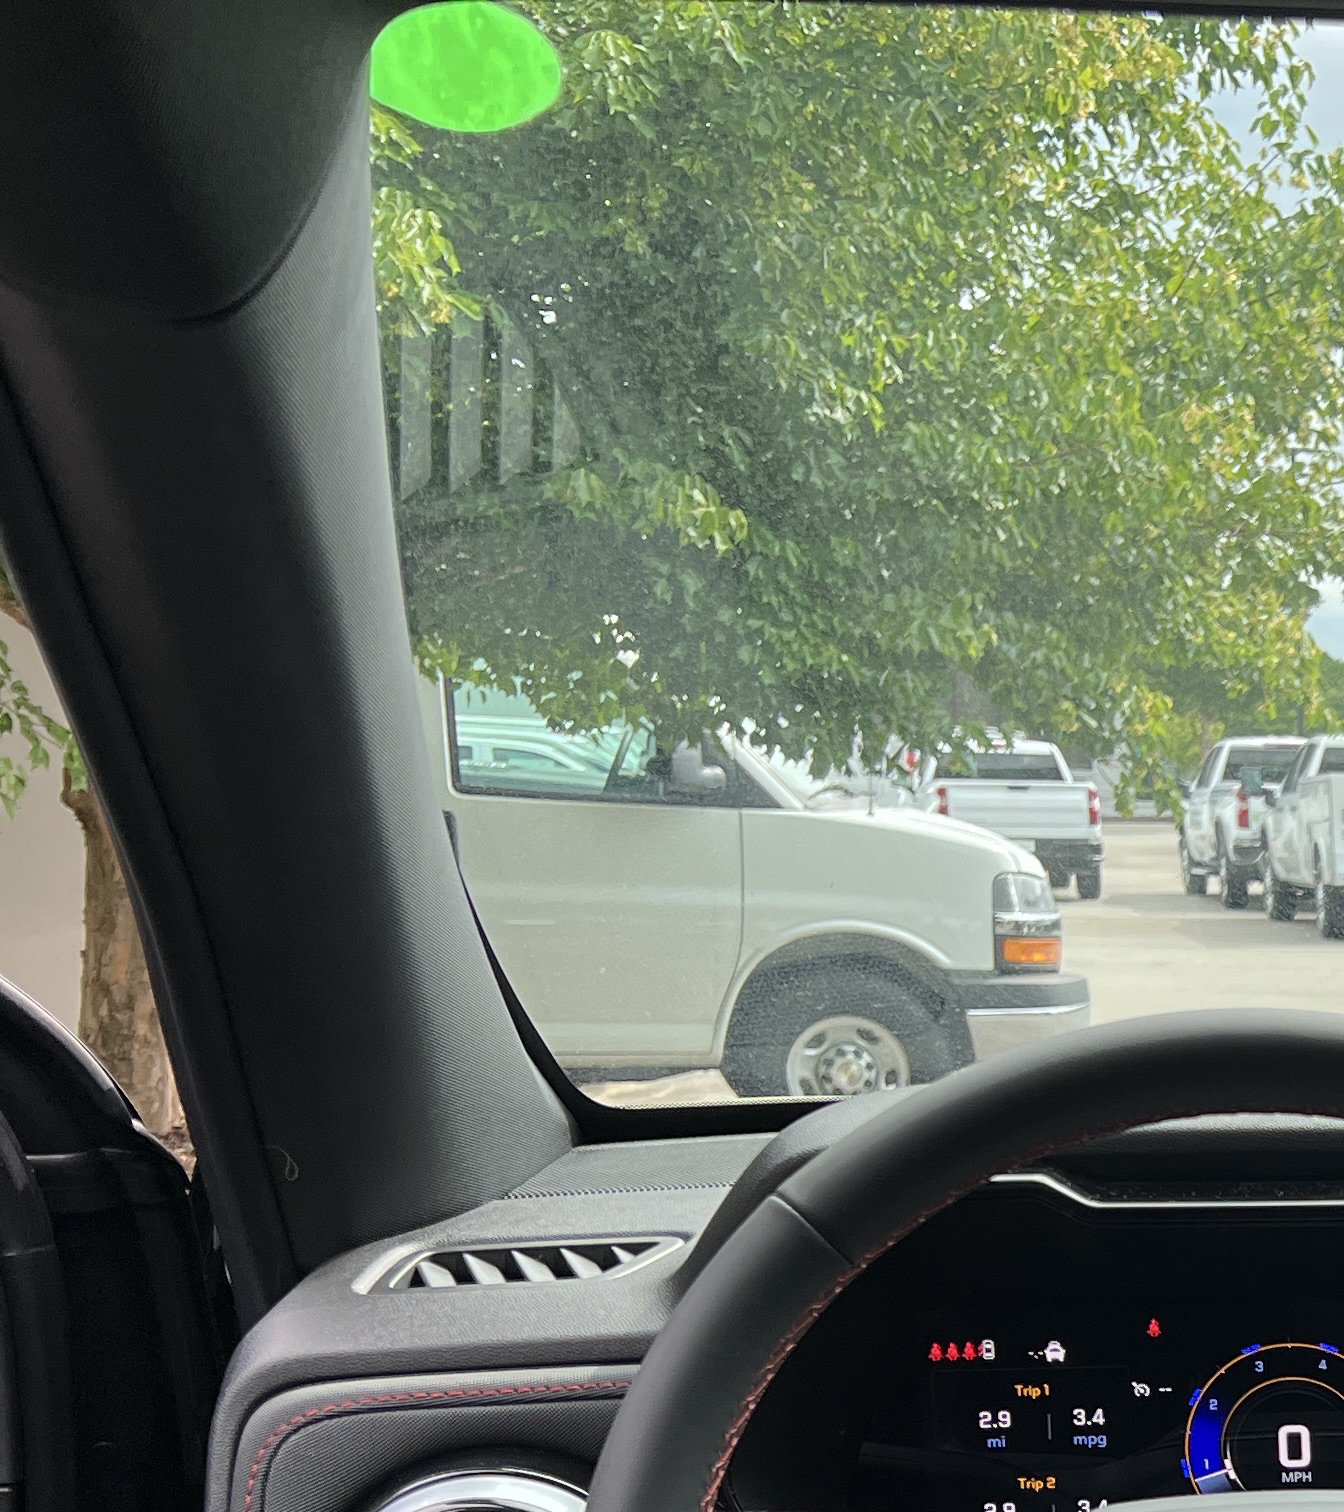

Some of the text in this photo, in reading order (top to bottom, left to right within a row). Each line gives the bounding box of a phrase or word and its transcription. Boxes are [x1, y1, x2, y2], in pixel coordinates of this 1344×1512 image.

[1254, 1360, 1265, 1373] 3
[1318, 1359, 1328, 1371] 4
[1014, 1384, 1050, 1400] Trip 1
[1208, 1398, 1218, 1411] 2
[978, 1410, 1012, 1429] 2.9
[1072, 1408, 1106, 1427] 3.4
[986, 1435, 1006, 1449] mi
[1073, 1434, 1107, 1448] mpg
[1277, 1424, 1312, 1469] 0
[1203, 1458, 1210, 1471] 1
[1017, 1477, 1056, 1492] Trip 2
[1281, 1471, 1313, 1484] MPH
